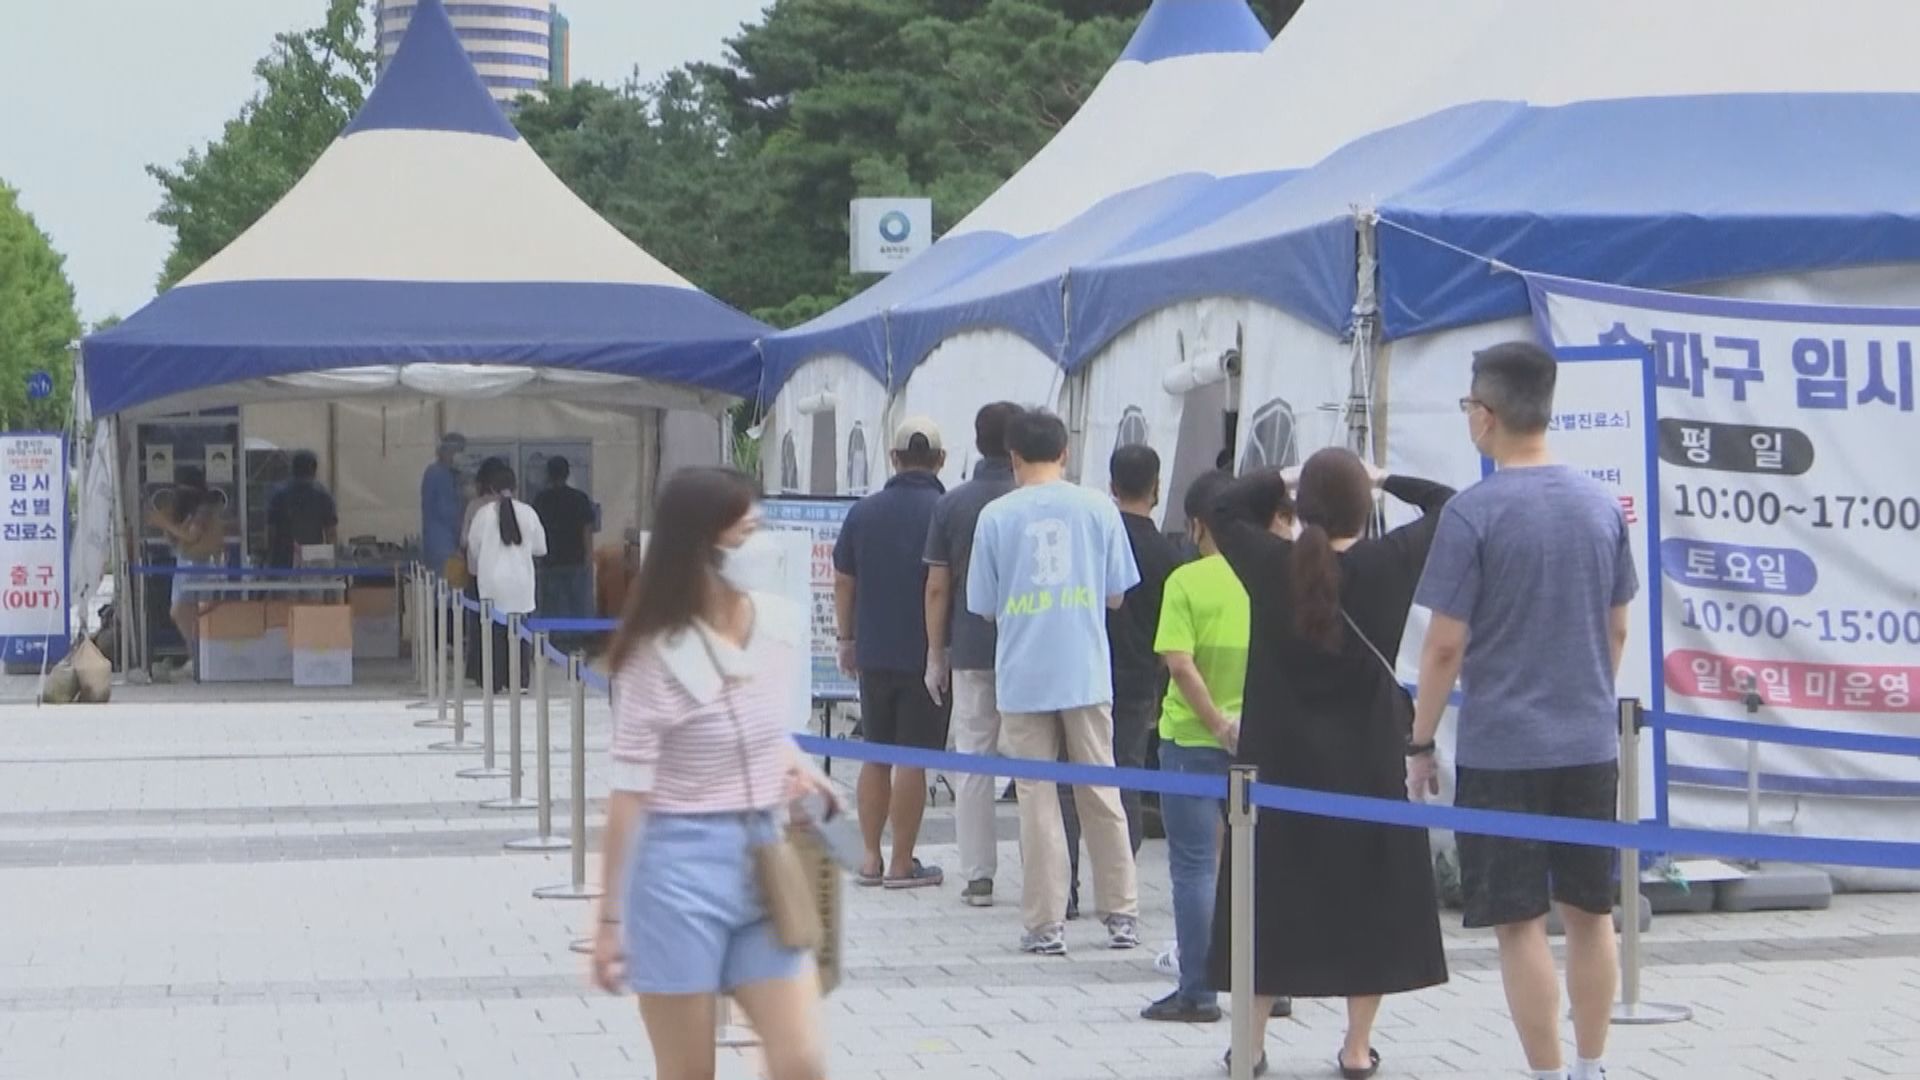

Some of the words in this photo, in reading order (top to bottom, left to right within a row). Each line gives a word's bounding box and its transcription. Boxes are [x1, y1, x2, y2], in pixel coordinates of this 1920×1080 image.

[1791, 337, 1914, 411] 임시
[1674, 484, 1920, 531] 10:00~17:00
[4, 523, 57, 541] 진료소
[1685, 548, 1788, 590] 토요일
[3, 589, 60, 609] (OUT)
[1681, 598, 1920, 643] 10:00~15:00
[1691, 658, 1792, 703] 일요일
[1805, 671, 1910, 707] 미운영
